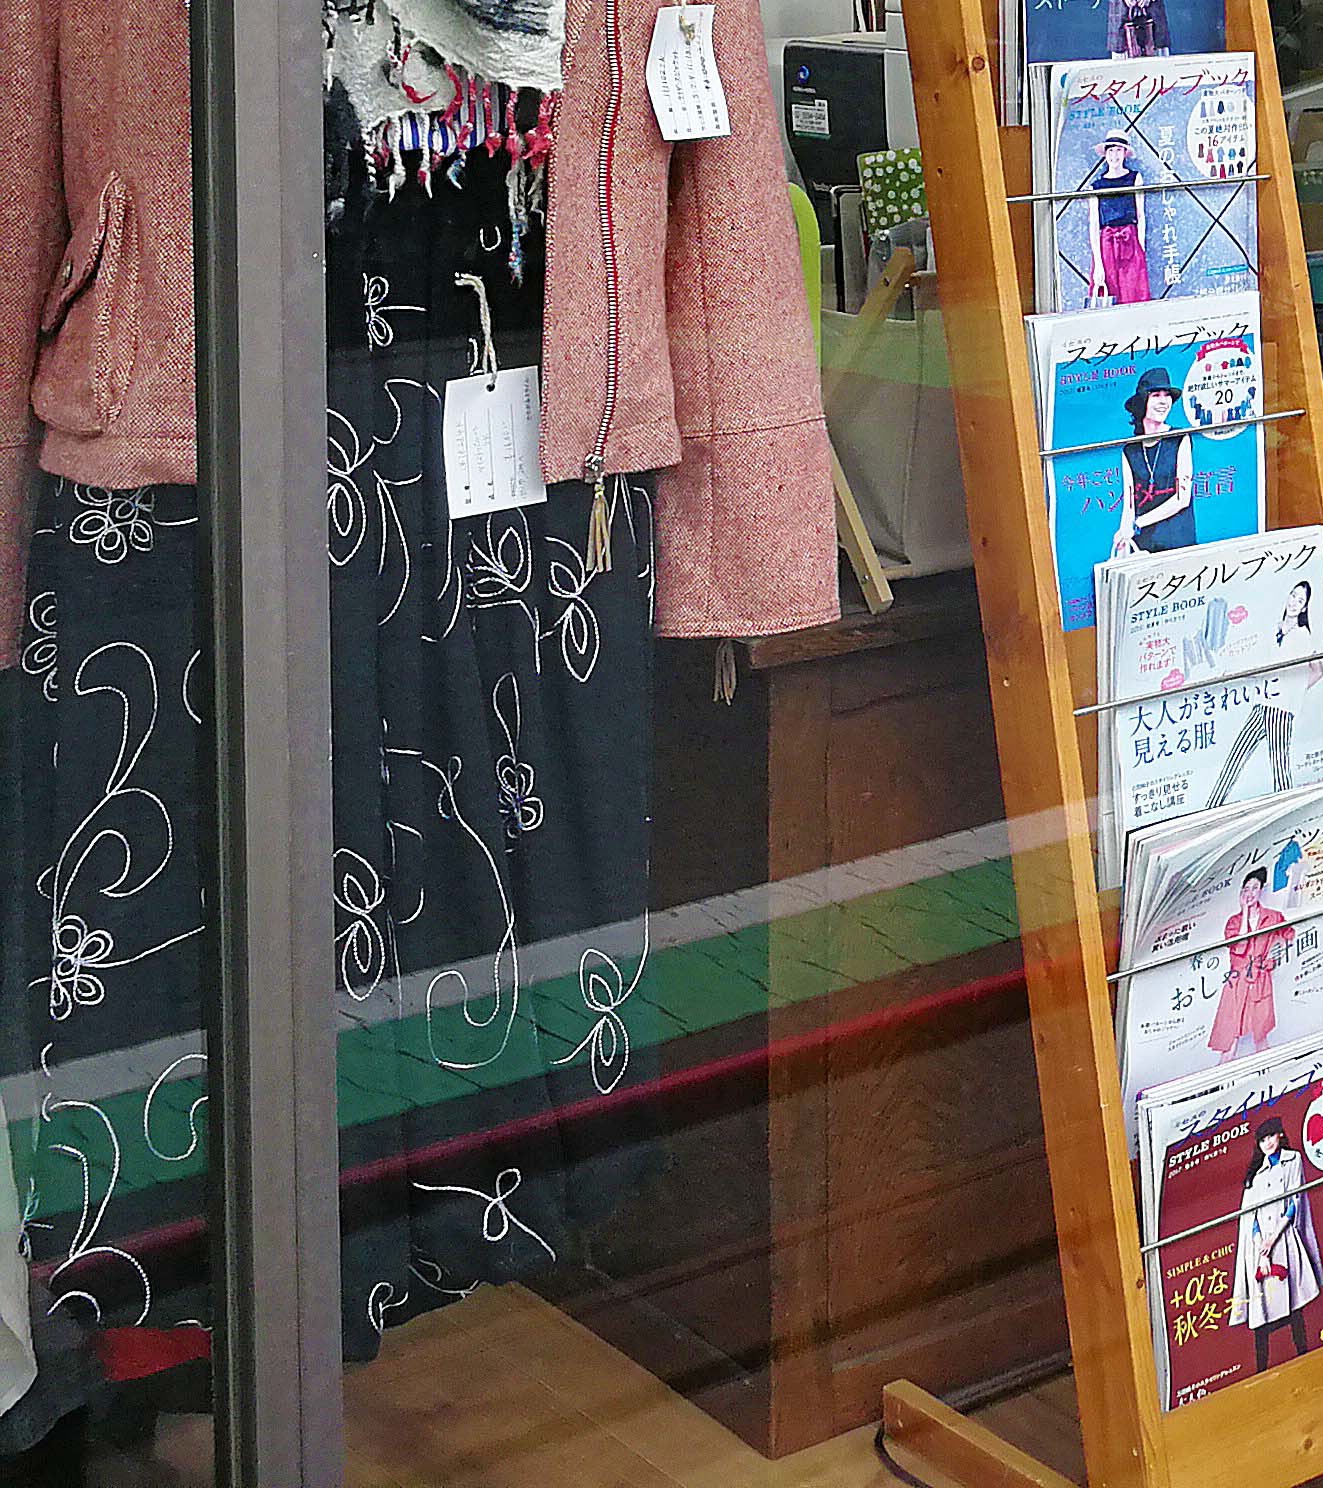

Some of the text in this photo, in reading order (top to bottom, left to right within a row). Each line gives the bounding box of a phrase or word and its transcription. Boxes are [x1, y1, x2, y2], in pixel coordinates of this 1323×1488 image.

[1071, 68, 1249, 105] スタイルブック
[1062, 322, 1250, 370] スタイルブック
[1214, 388, 1234, 406] 20
[1129, 543, 1318, 609] スタイルブック
[1130, 604, 1169, 624] STYLE
[1172, 595, 1206, 613] BOOK
[1129, 677, 1281, 738] 大人がきれいに
[1132, 720, 1217, 769] 見える服
[1168, 1139, 1210, 1168] STYLE
[1212, 1121, 1250, 1148] BOOK
[1166, 1256, 1201, 1280] SIMPLE
[1210, 1242, 1235, 1260] CHIC
